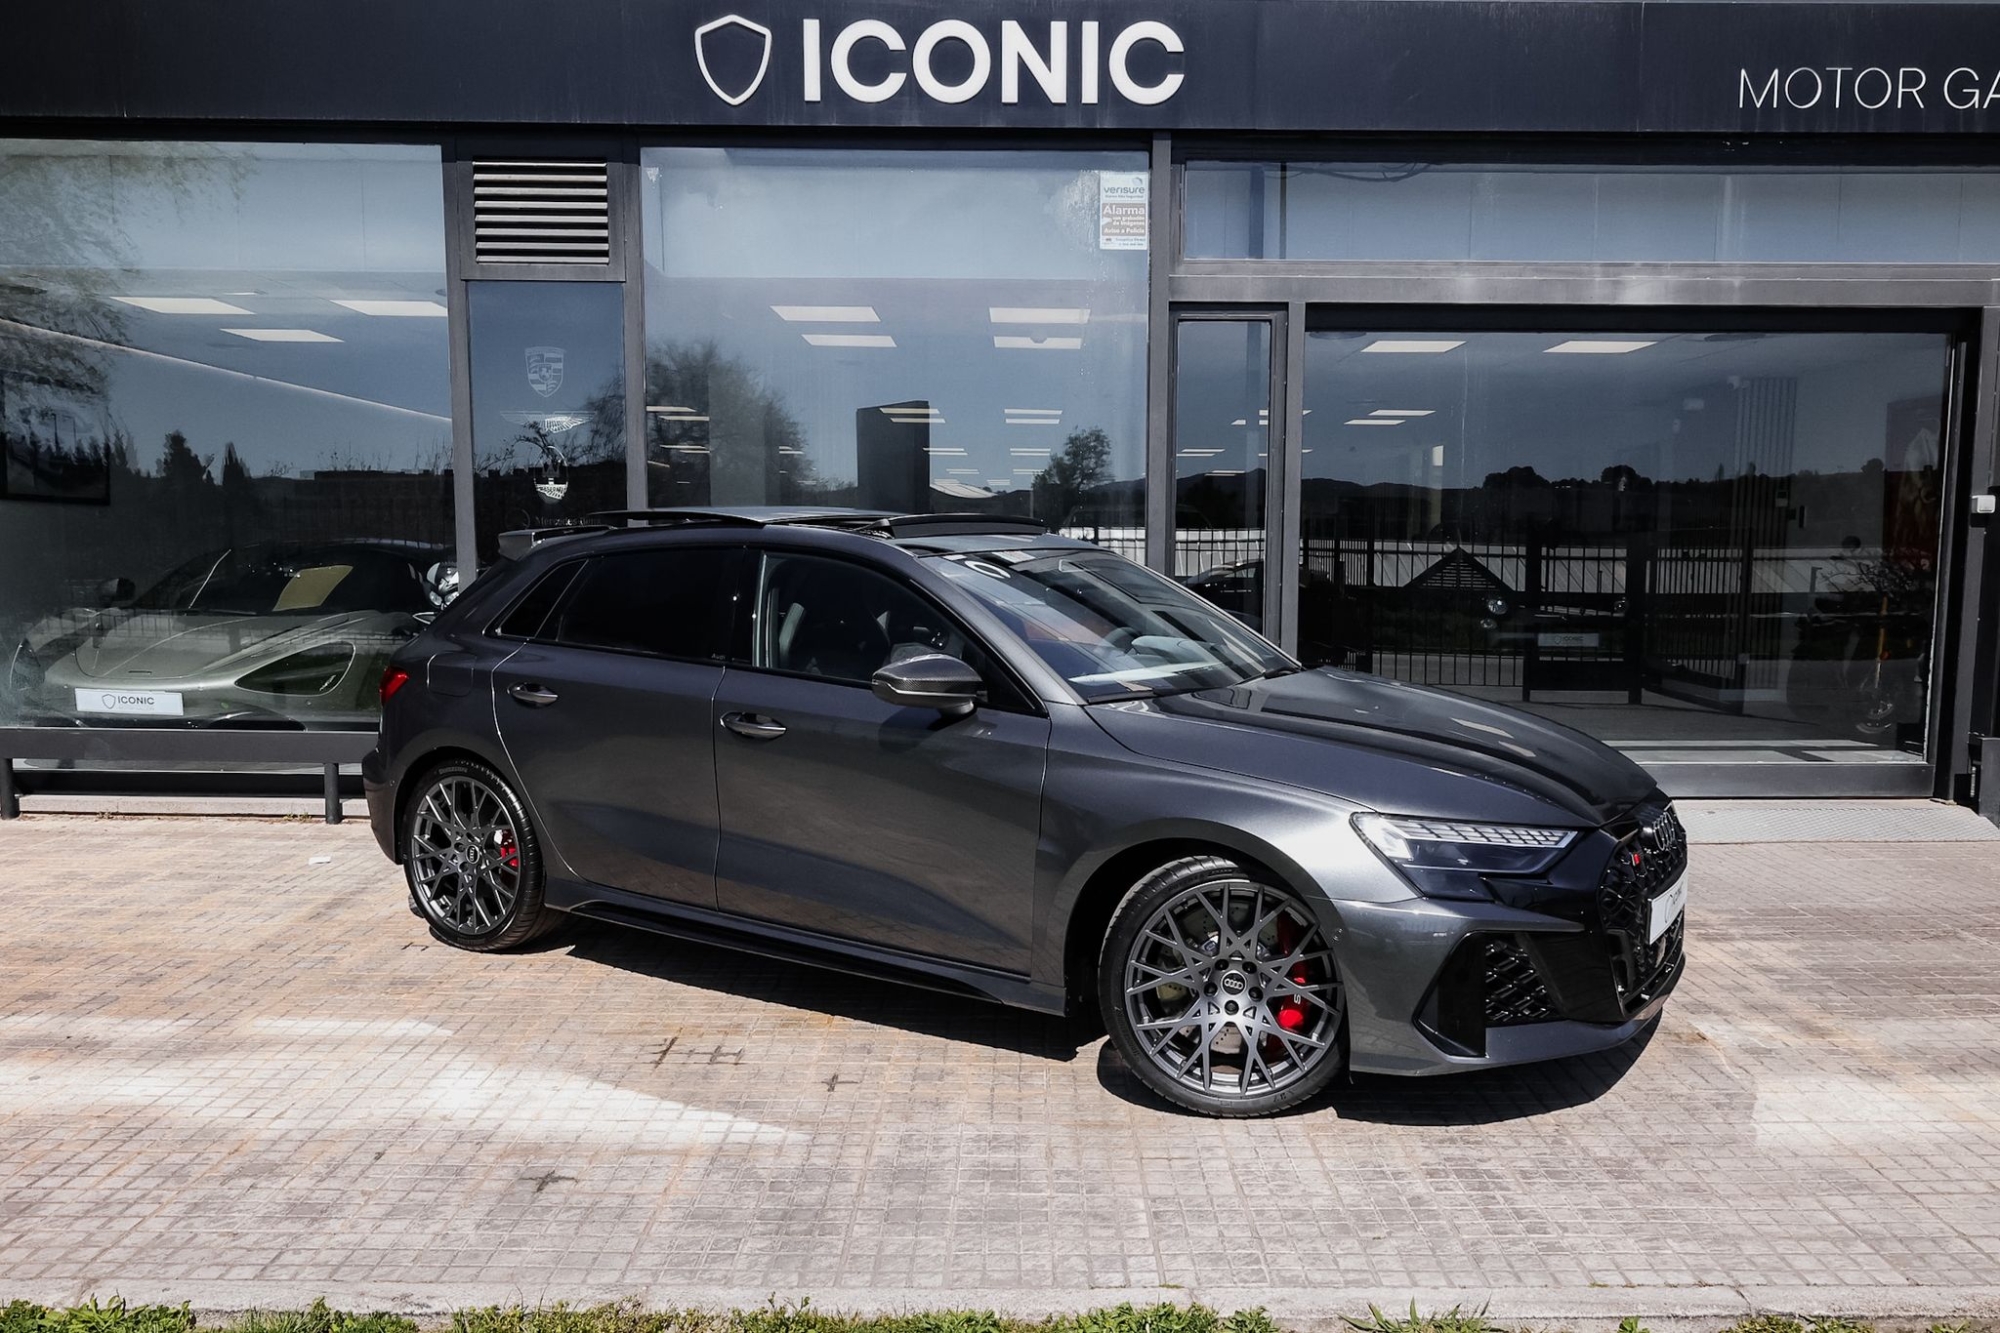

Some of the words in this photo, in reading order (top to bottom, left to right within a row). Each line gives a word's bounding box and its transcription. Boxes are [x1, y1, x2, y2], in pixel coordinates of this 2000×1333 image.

[802, 19, 1186, 105] ICONIC
[1738, 66, 1927, 110] MOTOR
[1103, 186, 1145, 194] verisure
[117, 695, 155, 705] ICONIC
